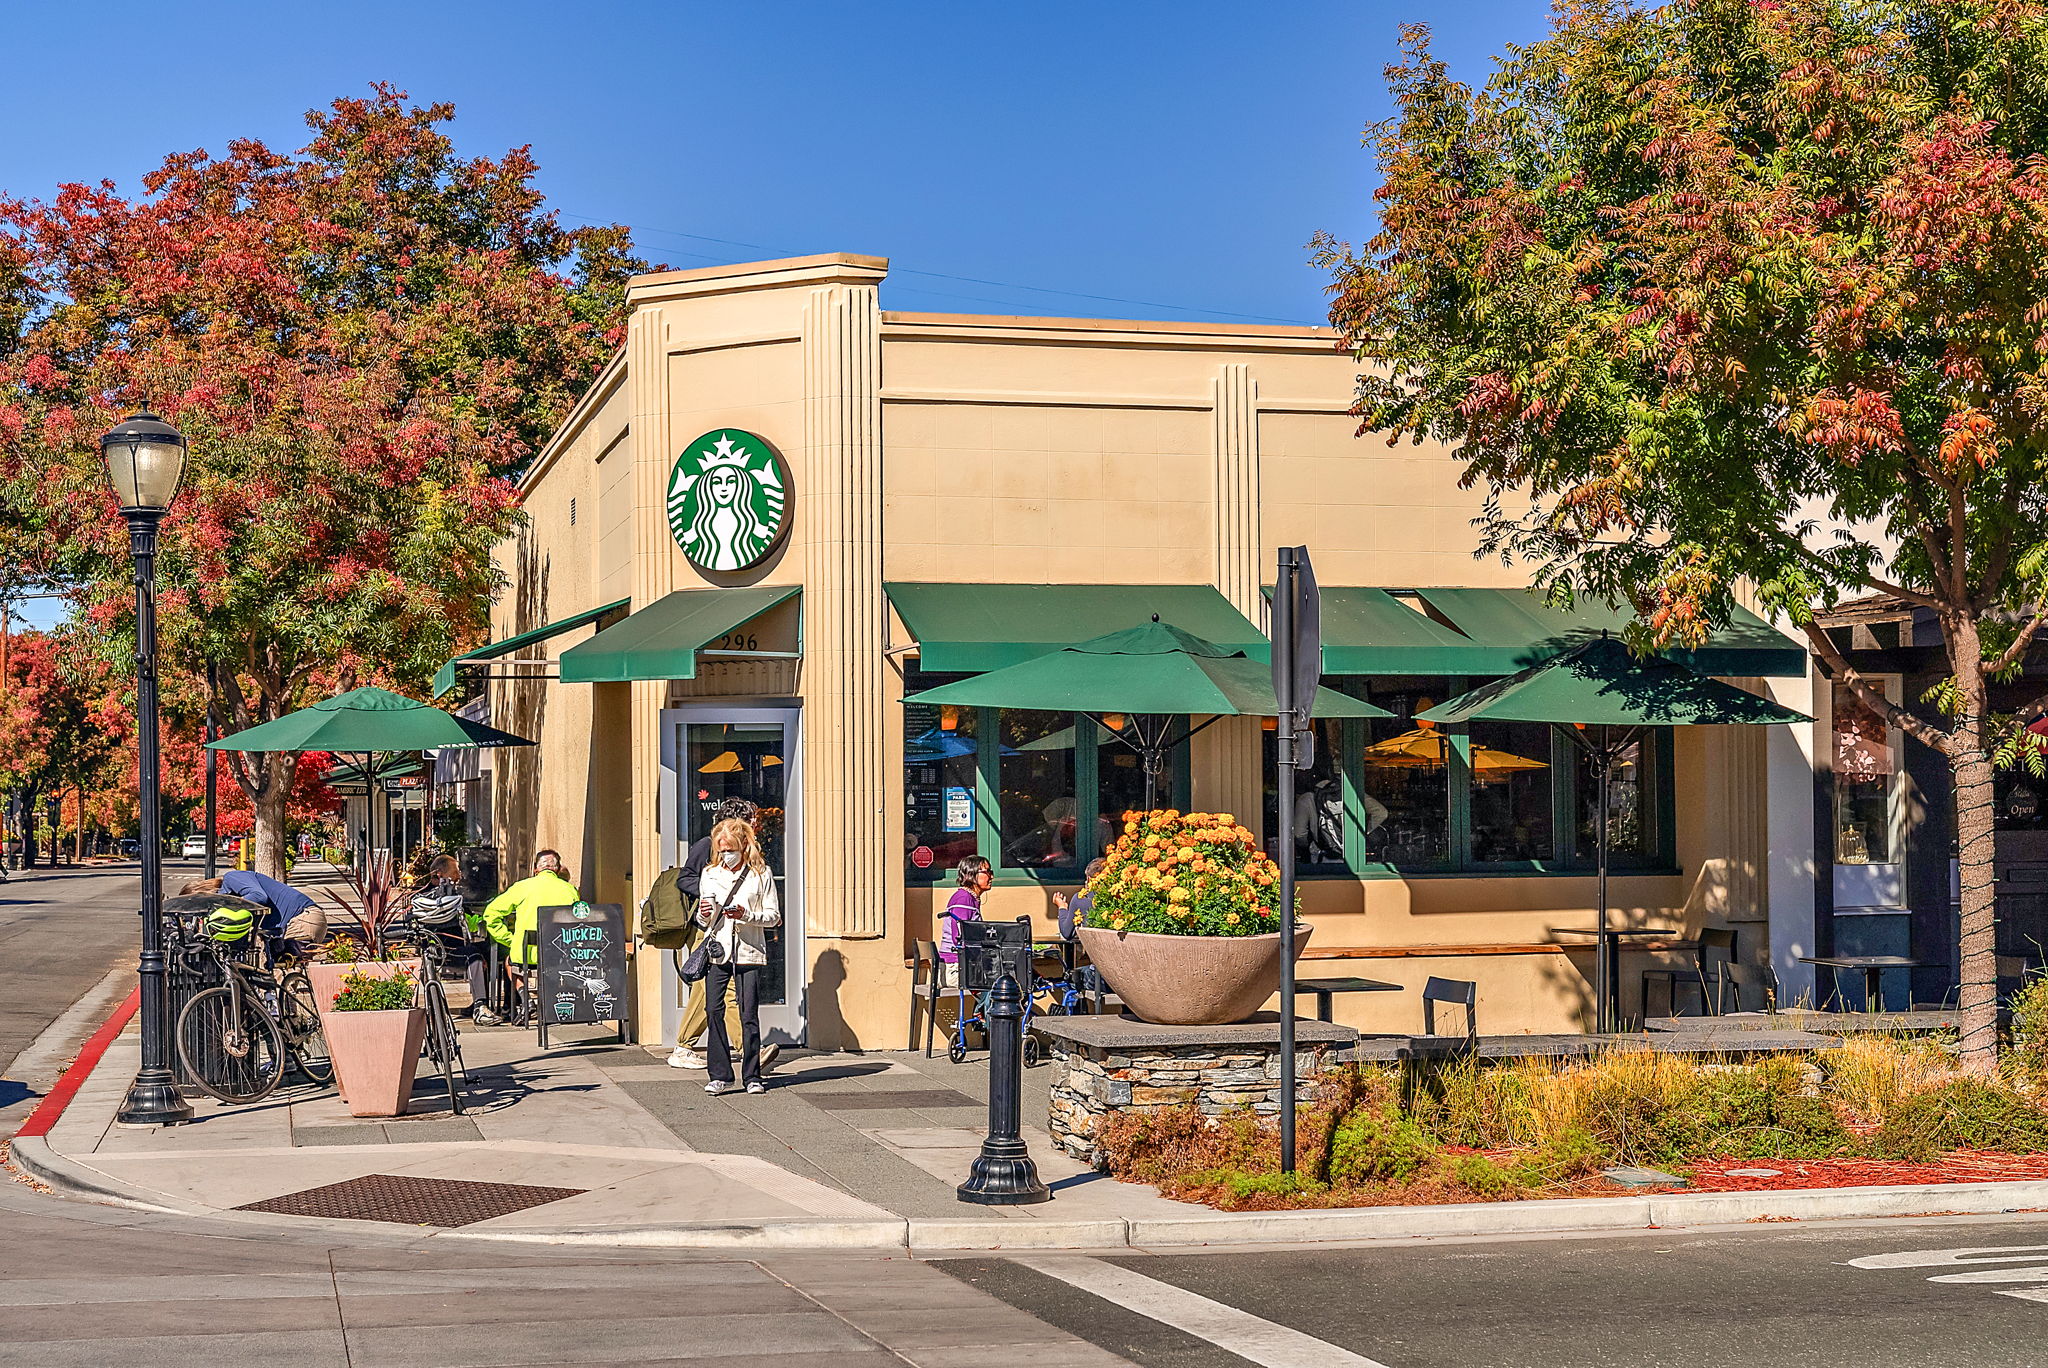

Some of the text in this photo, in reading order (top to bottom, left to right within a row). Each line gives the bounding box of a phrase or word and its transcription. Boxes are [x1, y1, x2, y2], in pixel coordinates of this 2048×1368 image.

[721, 633, 758, 650] 296
[2010, 804, 2035, 817] Open
[561, 927, 603, 944] WICKED
[570, 948, 600, 960] SBUX
